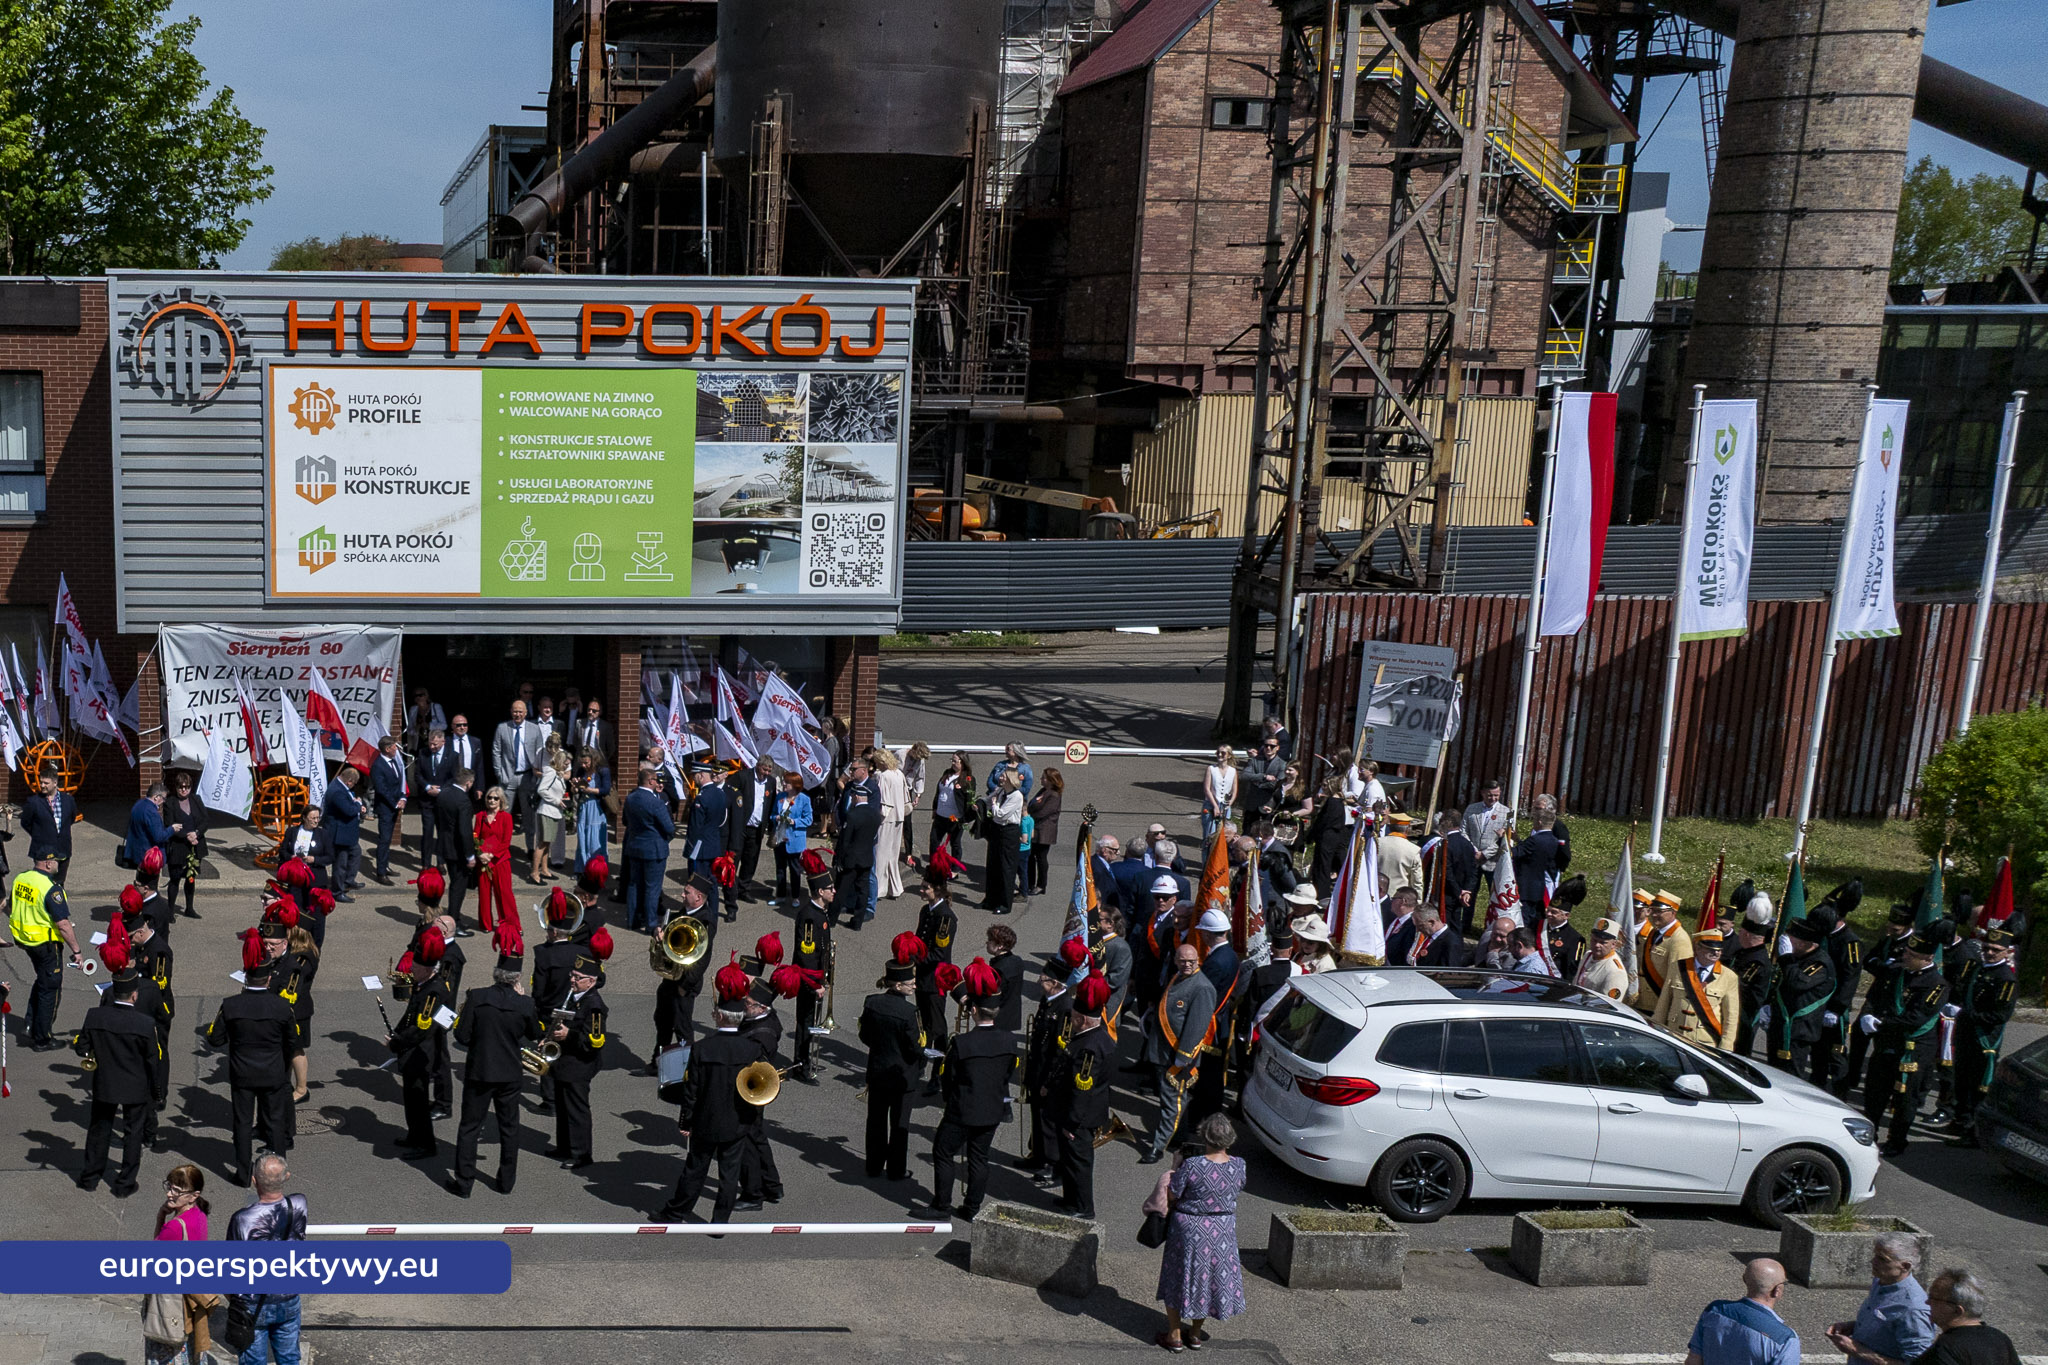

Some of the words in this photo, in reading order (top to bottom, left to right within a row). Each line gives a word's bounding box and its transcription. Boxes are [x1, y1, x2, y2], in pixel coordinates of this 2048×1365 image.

[288, 299, 543, 353] HUTA
[581, 293, 887, 357] POKÓJ
[348, 394, 381, 405] HUTA
[383, 392, 422, 406] POKÓJ
[509, 391, 591, 403] FORMOWANE
[593, 392, 611, 403] NA
[612, 392, 655, 404] ZIMNO
[348, 408, 421, 424] PROFILE
[509, 407, 589, 418] WALCOWANE
[591, 408, 609, 418] NA
[611, 408, 663, 420] GORĄCO
[509, 434, 594, 446] KONSTRUKCJE
[596, 435, 652, 446] STALOWE
[509, 449, 606, 461] KSZTAŁTOWNIKI
[608, 450, 665, 461] SPAWANE
[344, 466, 377, 476] HUTA
[379, 463, 418, 477] POKÓJ
[344, 480, 471, 496] KONSTRUKCJE
[509, 478, 553, 489] USŁUGI
[554, 478, 653, 490] LABORATORYJNE
[509, 490, 569, 504] SPRZEDAŻ
[572, 493, 614, 507] PRĄDU
[621, 494, 655, 505] GAZU
[344, 534, 391, 549] HUTA
[395, 530, 453, 550] POKÓJ
[343, 551, 387, 563] SPÓŁKA
[389, 553, 440, 563] AKCYJNA
[226, 641, 311, 659] Sierpień
[319, 642, 343, 655] 80
[173, 665, 209, 684] TEN
[213, 665, 294, 681] ZAKŁAD
[187, 687, 310, 708] ZNISZZONY
[331, 686, 377, 704] RZEZ
[181, 709, 272, 735] POLITYĘ
[1069, 748, 1079, 756] 20
[809, 762, 822, 775] 80
